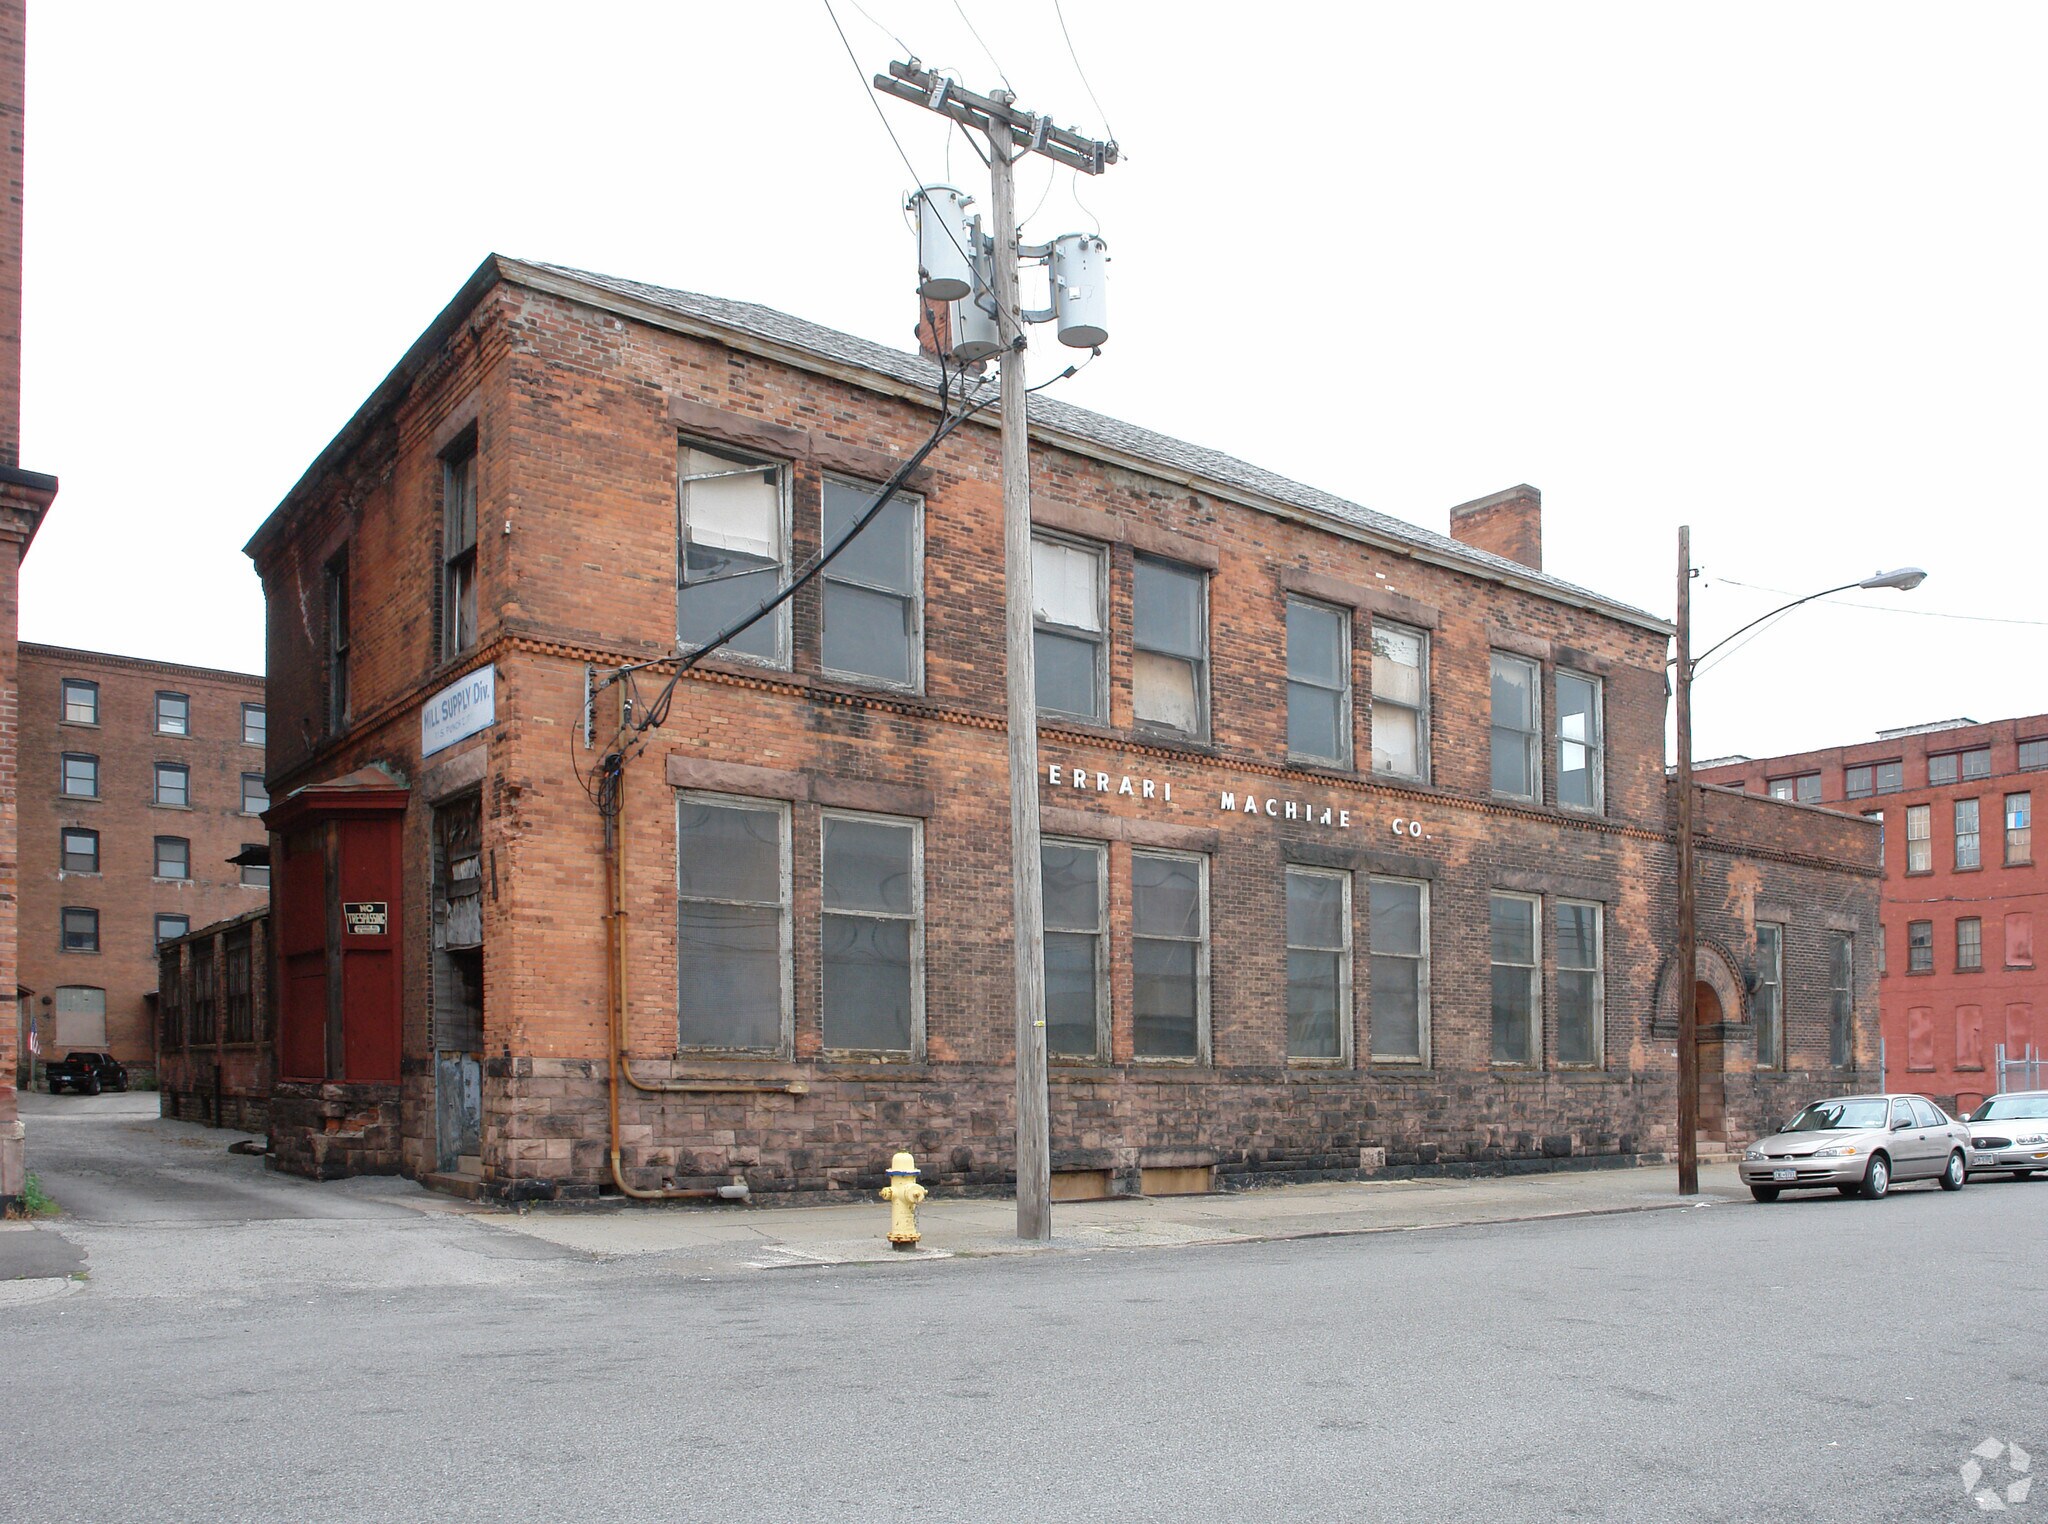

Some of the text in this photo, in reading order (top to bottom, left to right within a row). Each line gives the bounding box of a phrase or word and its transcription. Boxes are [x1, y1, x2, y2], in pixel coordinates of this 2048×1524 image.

[424, 705, 440, 732] MILL
[441, 686, 471, 721] SUPPLY
[473, 680, 490, 705] Div.
[1049, 764, 1171, 801] ERRARI
[1391, 818, 1431, 840] CO.
[347, 913, 385, 924] TRESPASSING
[359, 904, 374, 912] NO
